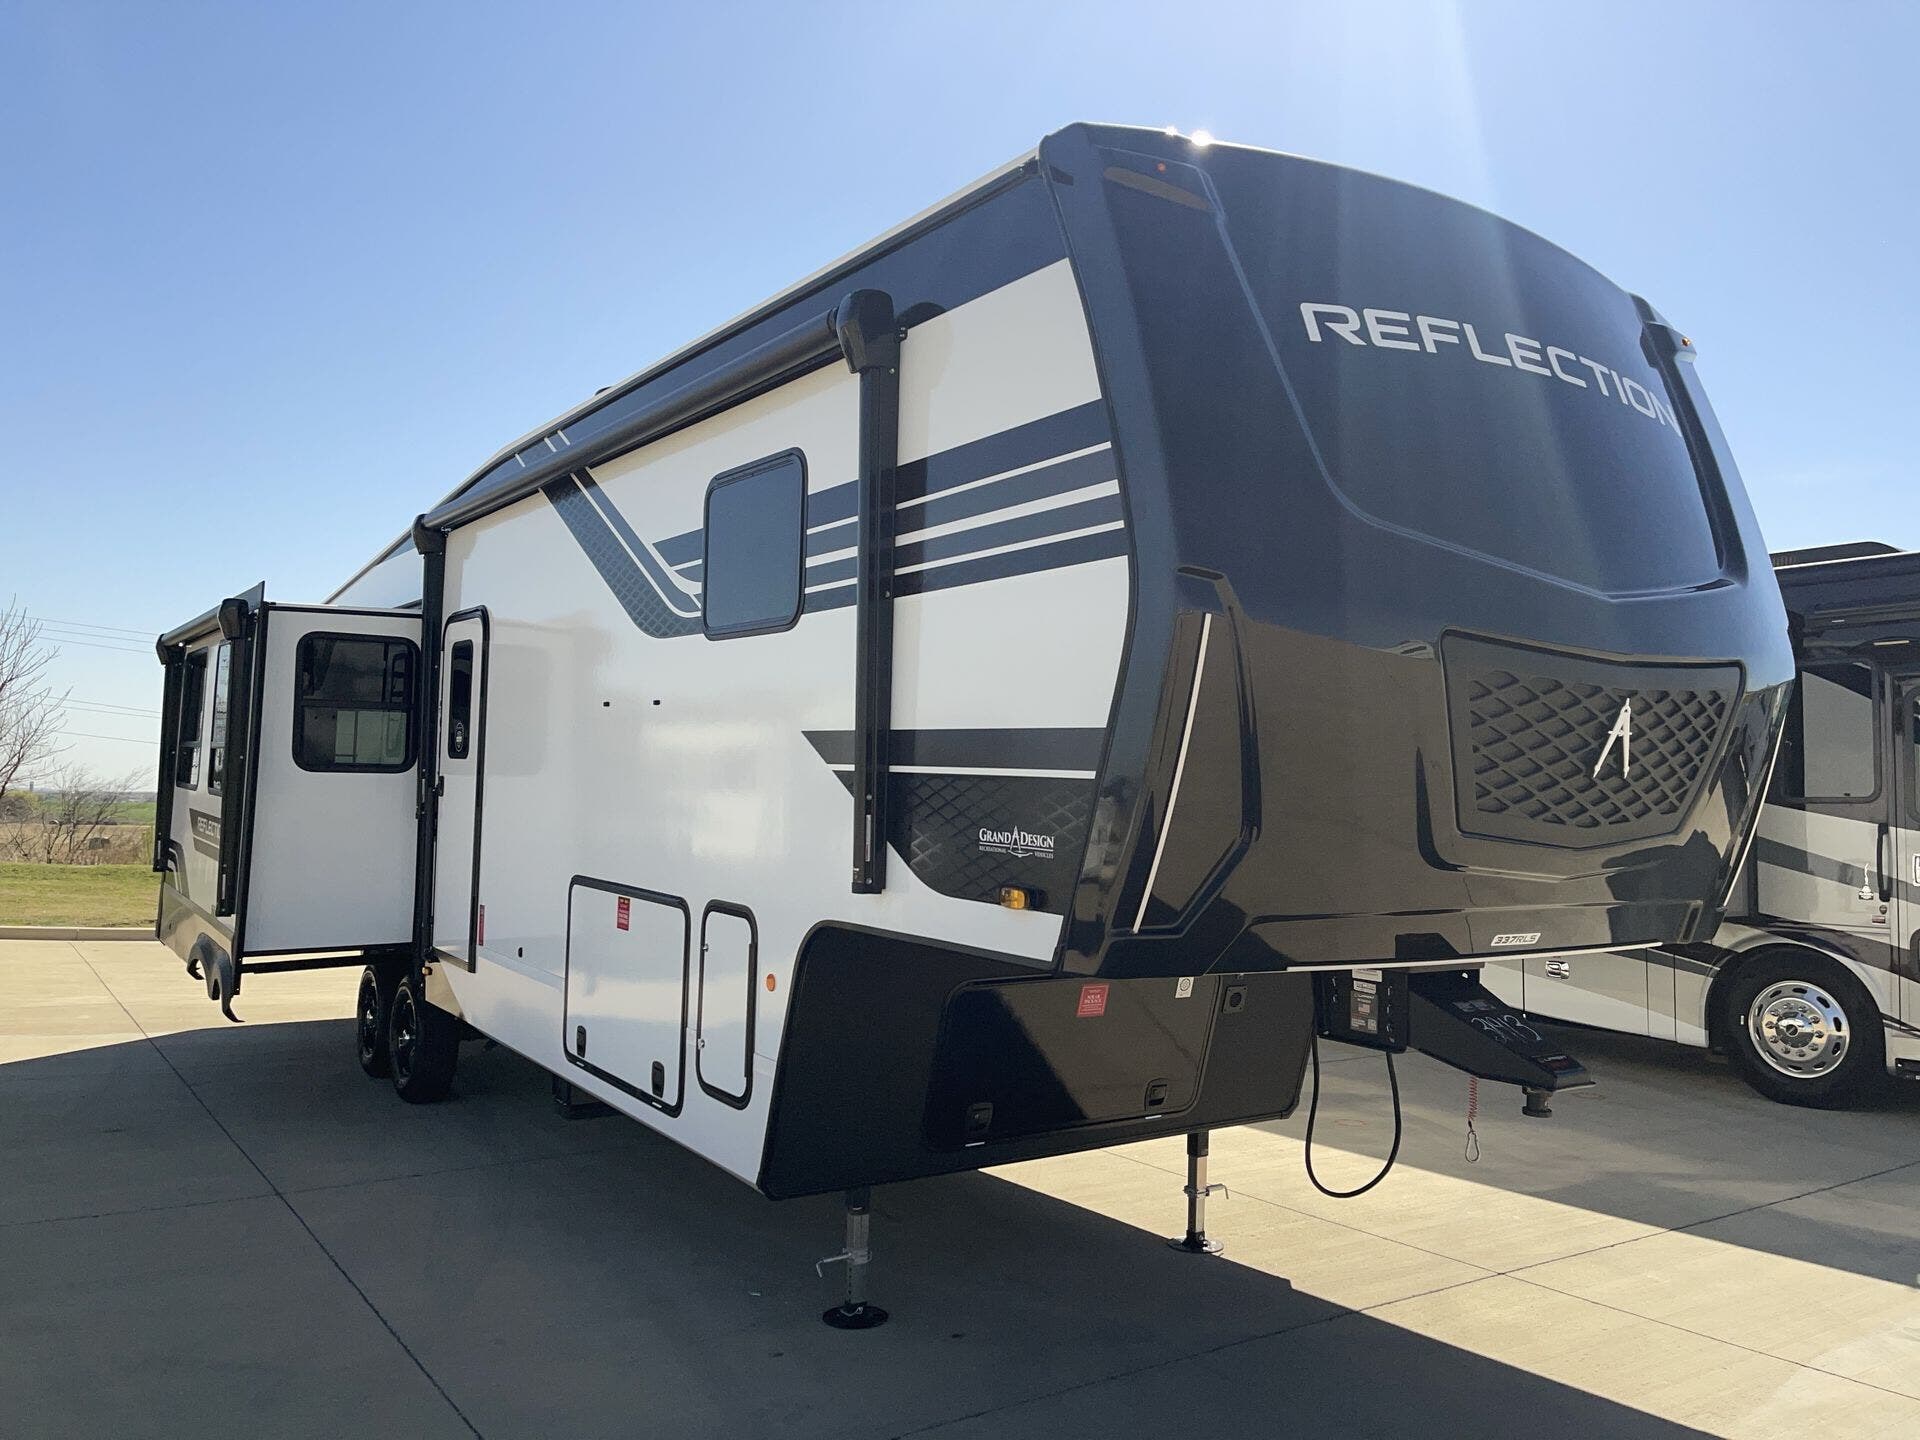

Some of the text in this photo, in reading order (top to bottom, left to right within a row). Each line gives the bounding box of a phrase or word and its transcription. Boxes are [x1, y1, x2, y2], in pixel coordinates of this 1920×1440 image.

[1300, 302, 1682, 437] REFLECTION
[978, 827, 1055, 848] GRAND DESIGN
[1494, 934, 1538, 945] 337RLS
